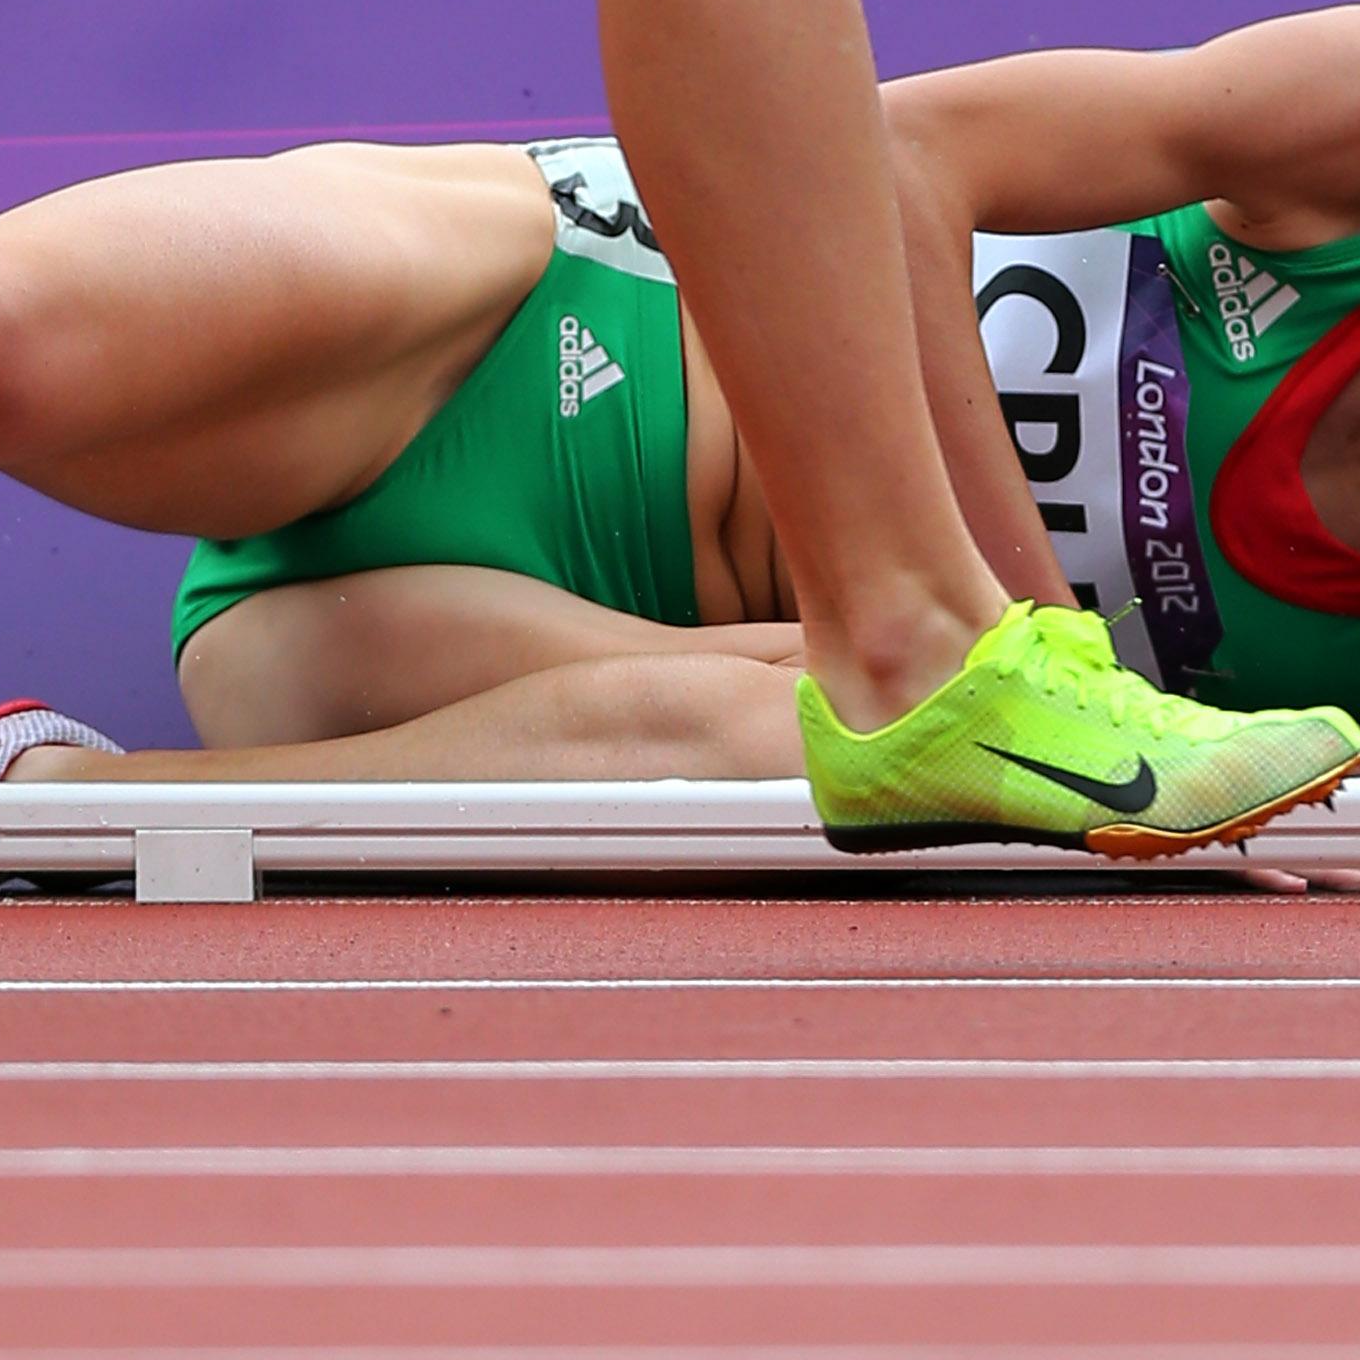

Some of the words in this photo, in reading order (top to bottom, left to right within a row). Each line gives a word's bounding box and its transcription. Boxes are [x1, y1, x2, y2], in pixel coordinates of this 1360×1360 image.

[1208, 243, 1255, 362] adidas
[559, 316, 583, 418] adidas
[1136, 359, 1181, 528] London
[1146, 538, 1199, 613] 2012
